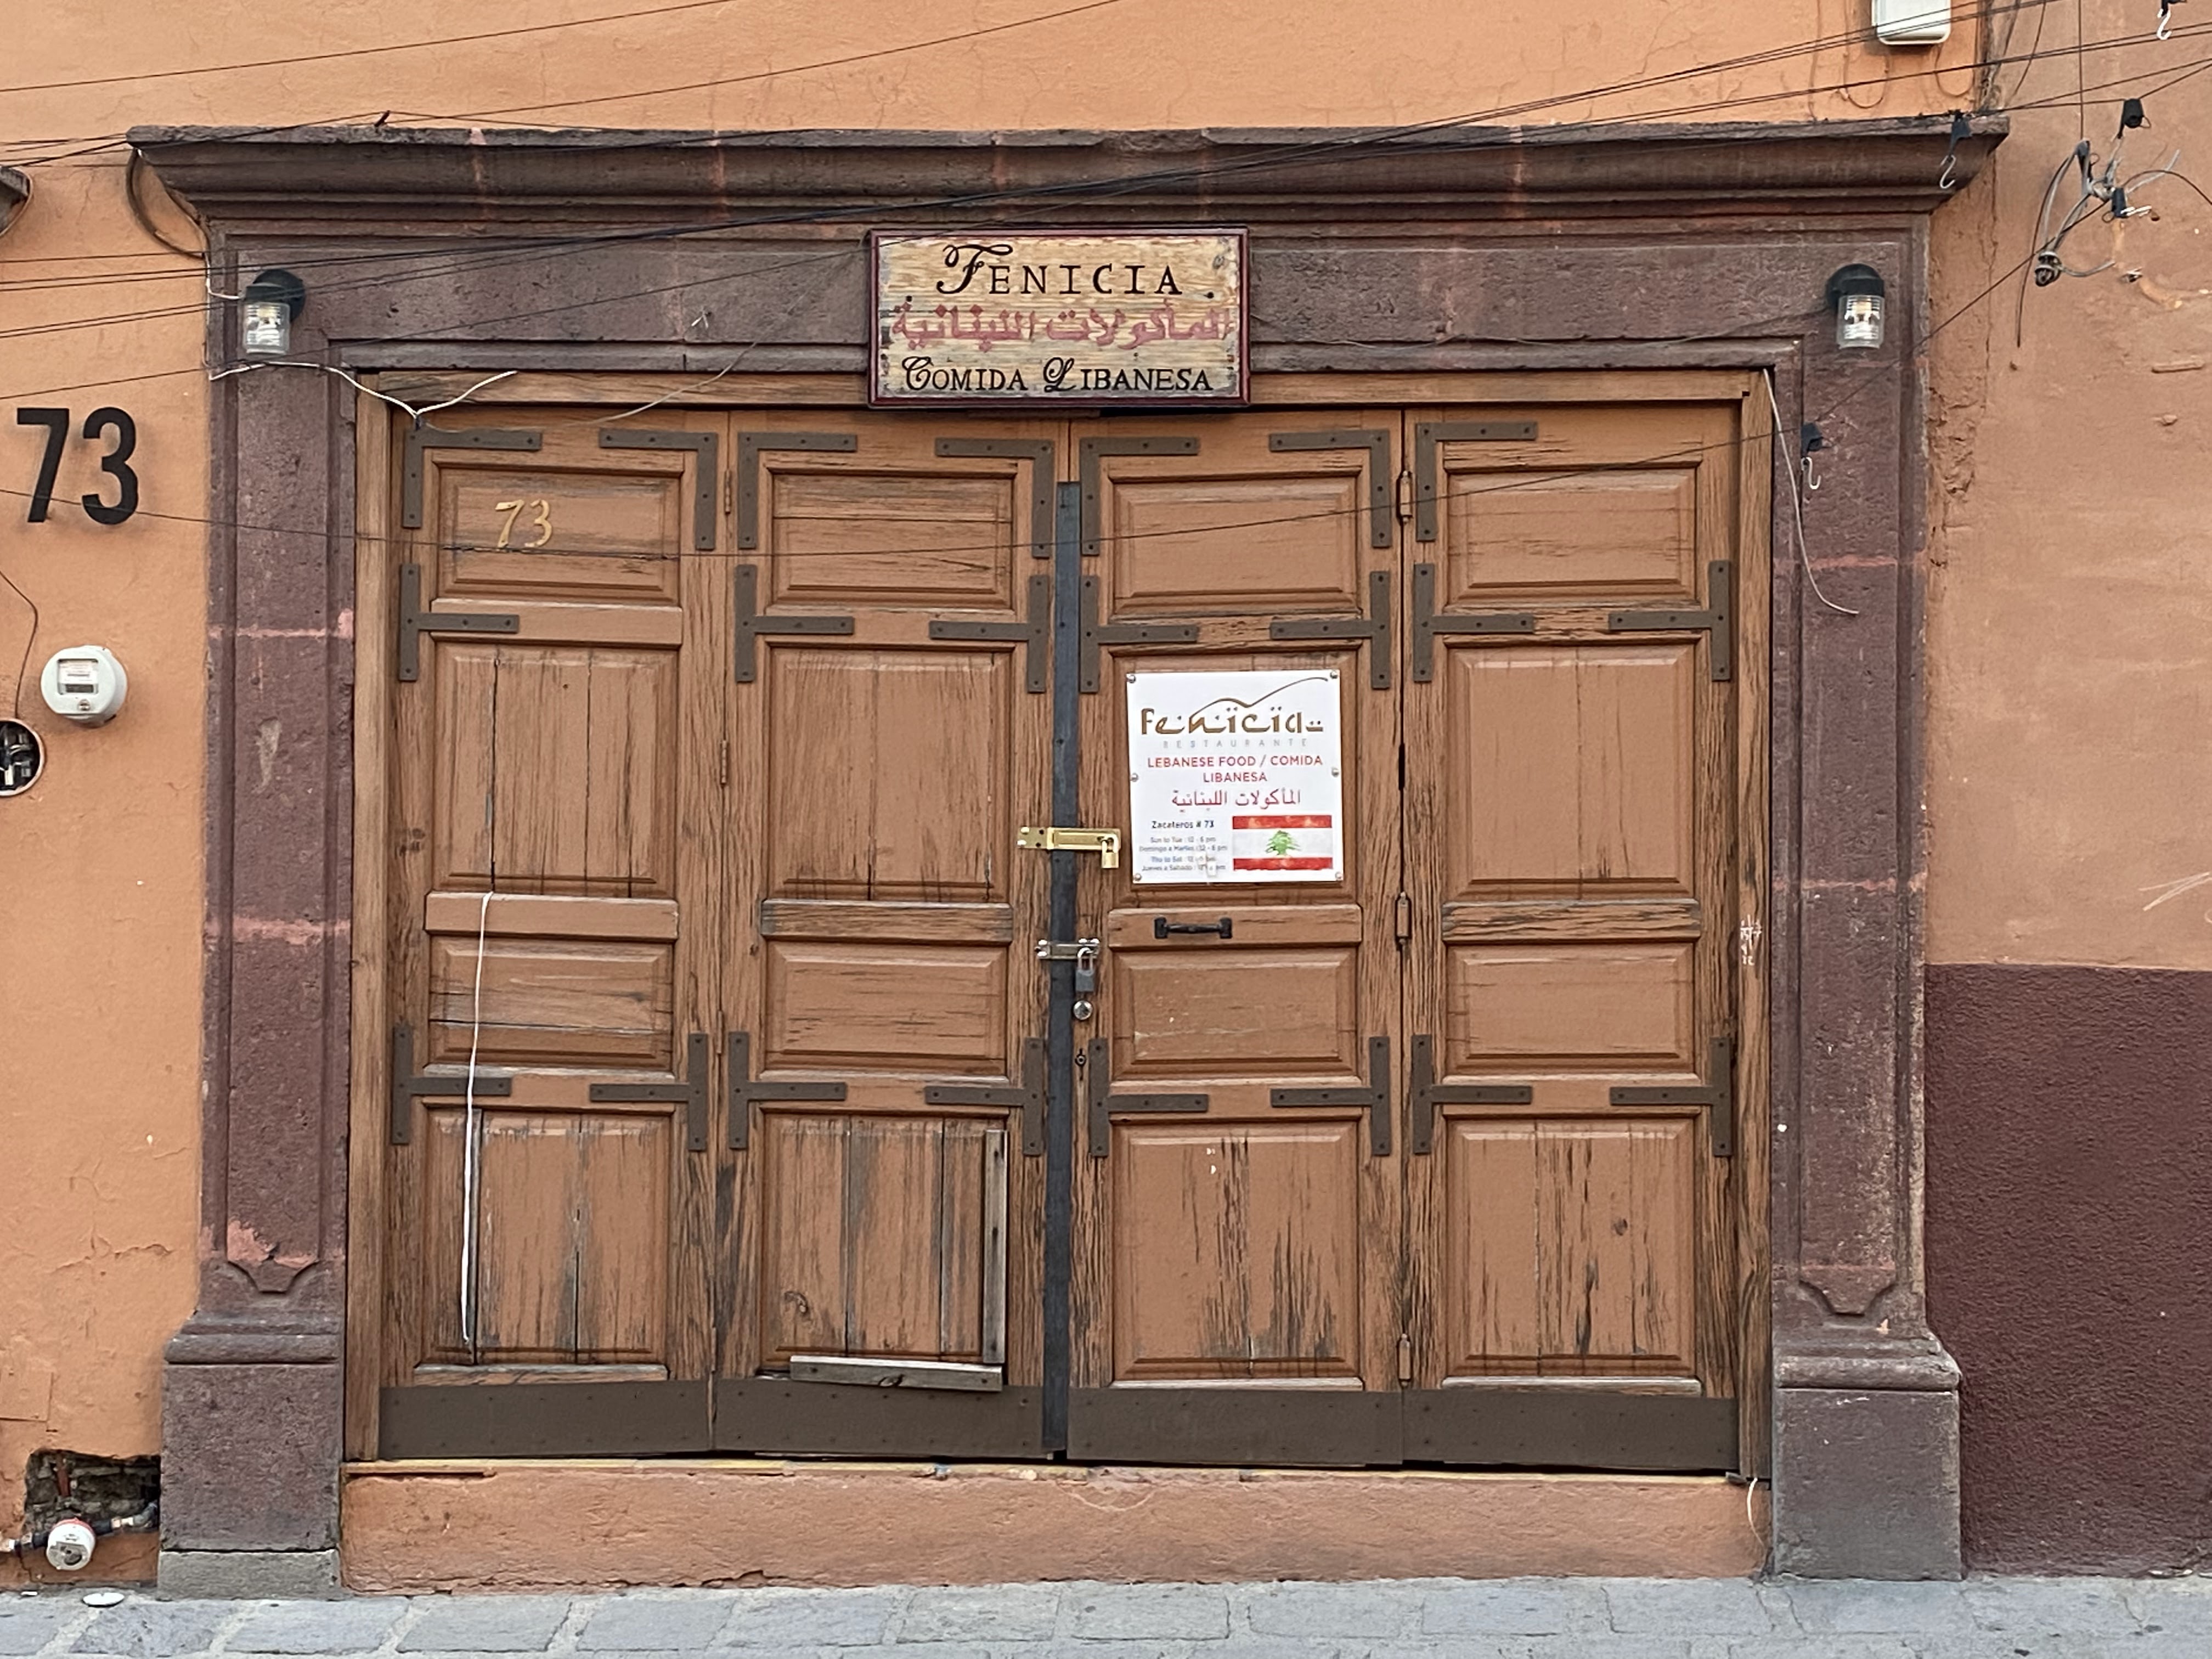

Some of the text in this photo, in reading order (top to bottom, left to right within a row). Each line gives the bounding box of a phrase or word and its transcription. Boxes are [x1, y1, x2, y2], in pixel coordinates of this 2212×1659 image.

[936, 244, 1183, 296] FENICIA
[901, 356, 1214, 393] COMIDA LIBANESA
[16, 407, 139, 525] 73
[495, 499, 552, 548] 73
[1163, 738, 1307, 748] RESTAURANTE
[1148, 754, 1323, 768] LEBANESE FOOD / COMIDA
[1203, 771, 1267, 783] LIBANESA
[1171, 787, 1301, 812] المأكولات اللبنانية
[1152, 820, 1193, 828] Zacateros
[1204, 820, 1215, 828] 73
